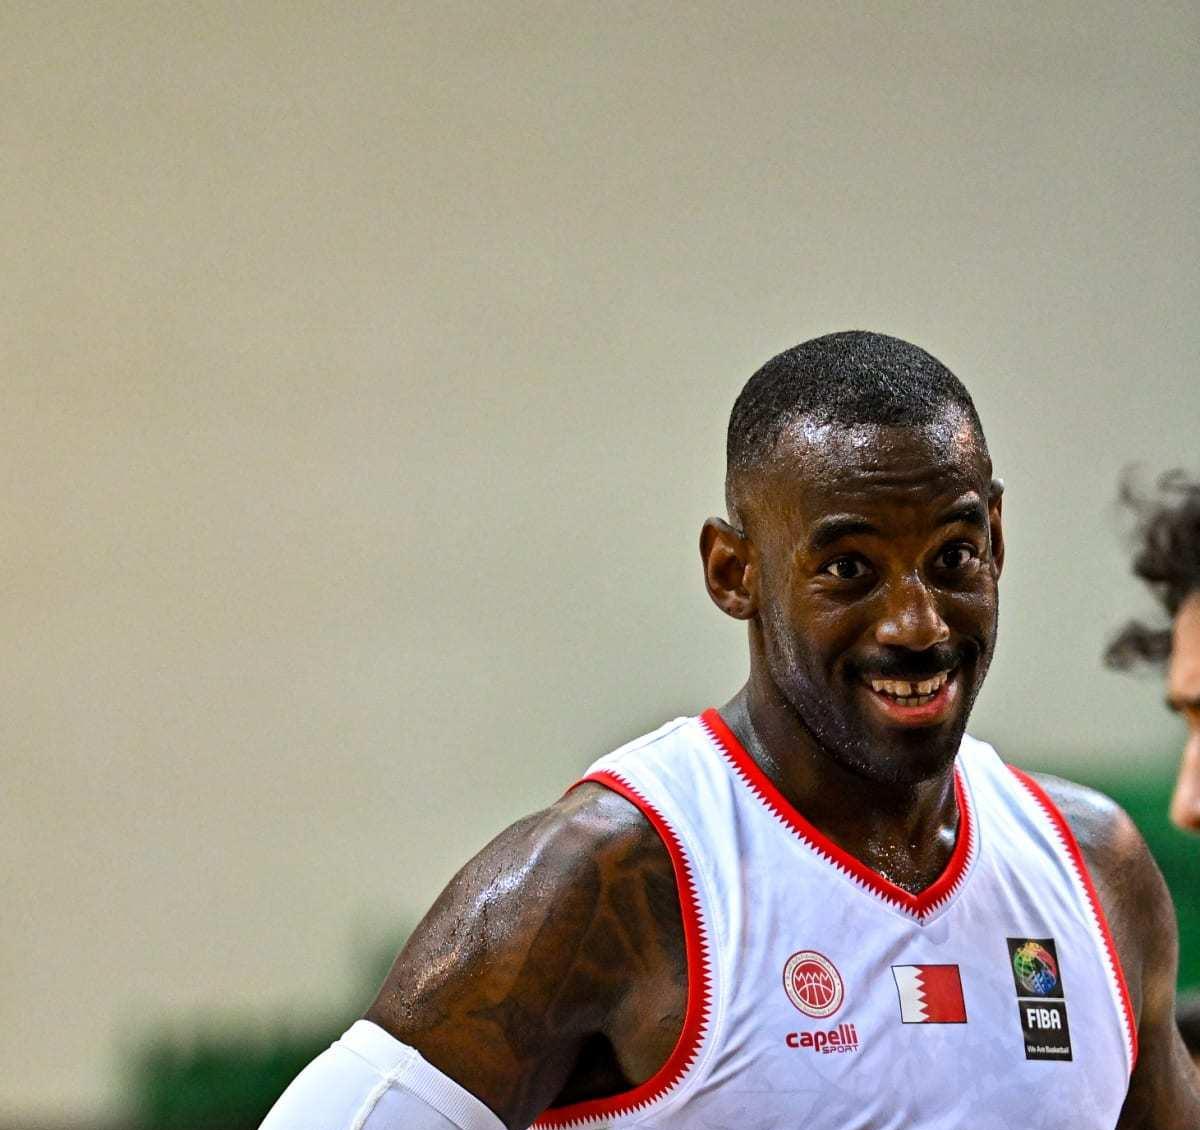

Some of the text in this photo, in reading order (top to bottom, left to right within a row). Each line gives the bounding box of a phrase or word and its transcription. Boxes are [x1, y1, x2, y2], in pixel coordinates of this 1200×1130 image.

[1027, 1008, 1062, 1029] FIBA
[785, 1023, 859, 1052] capelli
[822, 1045, 859, 1054] SPORT
